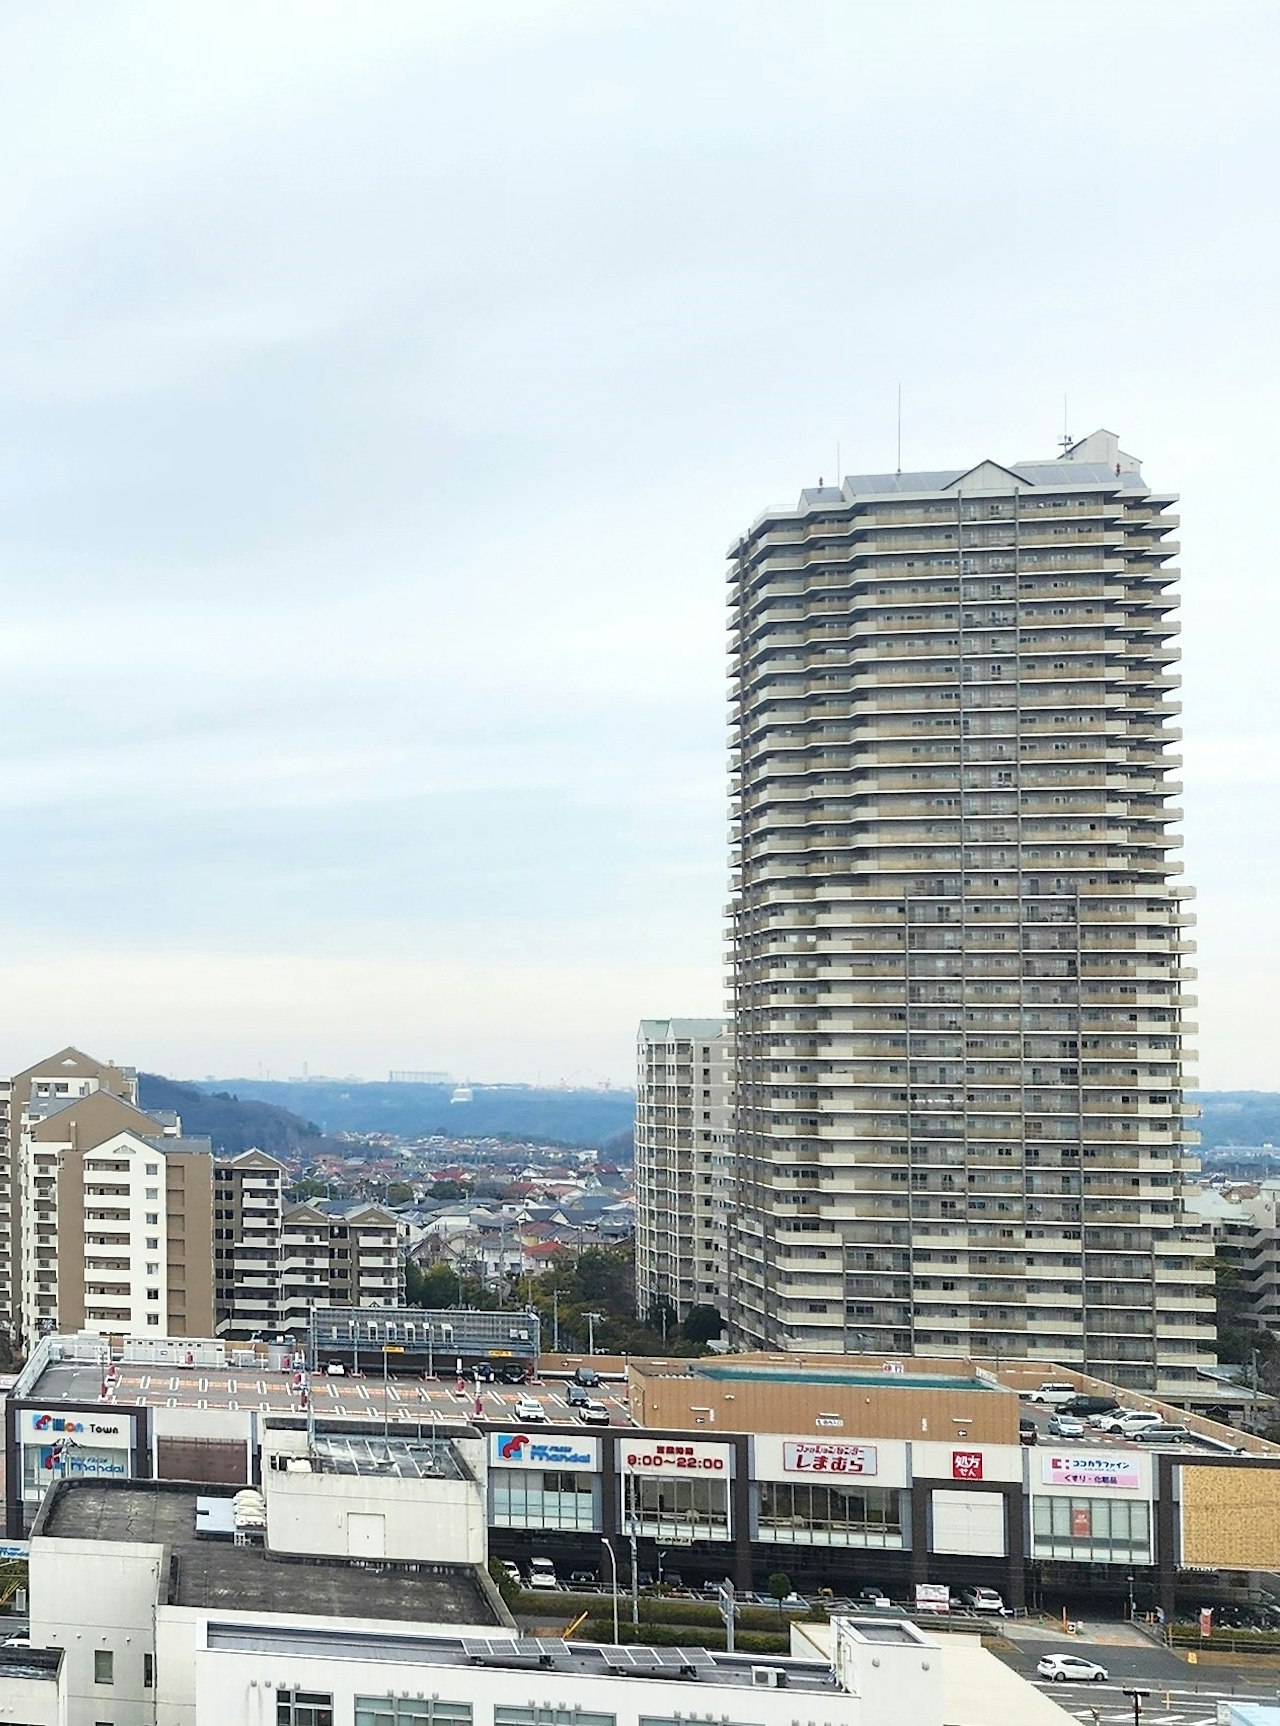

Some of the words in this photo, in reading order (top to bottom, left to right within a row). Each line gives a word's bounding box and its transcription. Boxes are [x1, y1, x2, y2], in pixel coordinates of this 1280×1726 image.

[89, 1423, 119, 1434] Town
[530, 1451, 591, 1463] mandai
[954, 1455, 981, 1468] 処方
[71, 1462, 124, 1473] mandai
[796, 1454, 865, 1472] しまむら
[1072, 1459, 1130, 1469] ココカラファイン
[959, 1468, 977, 1477] せん
